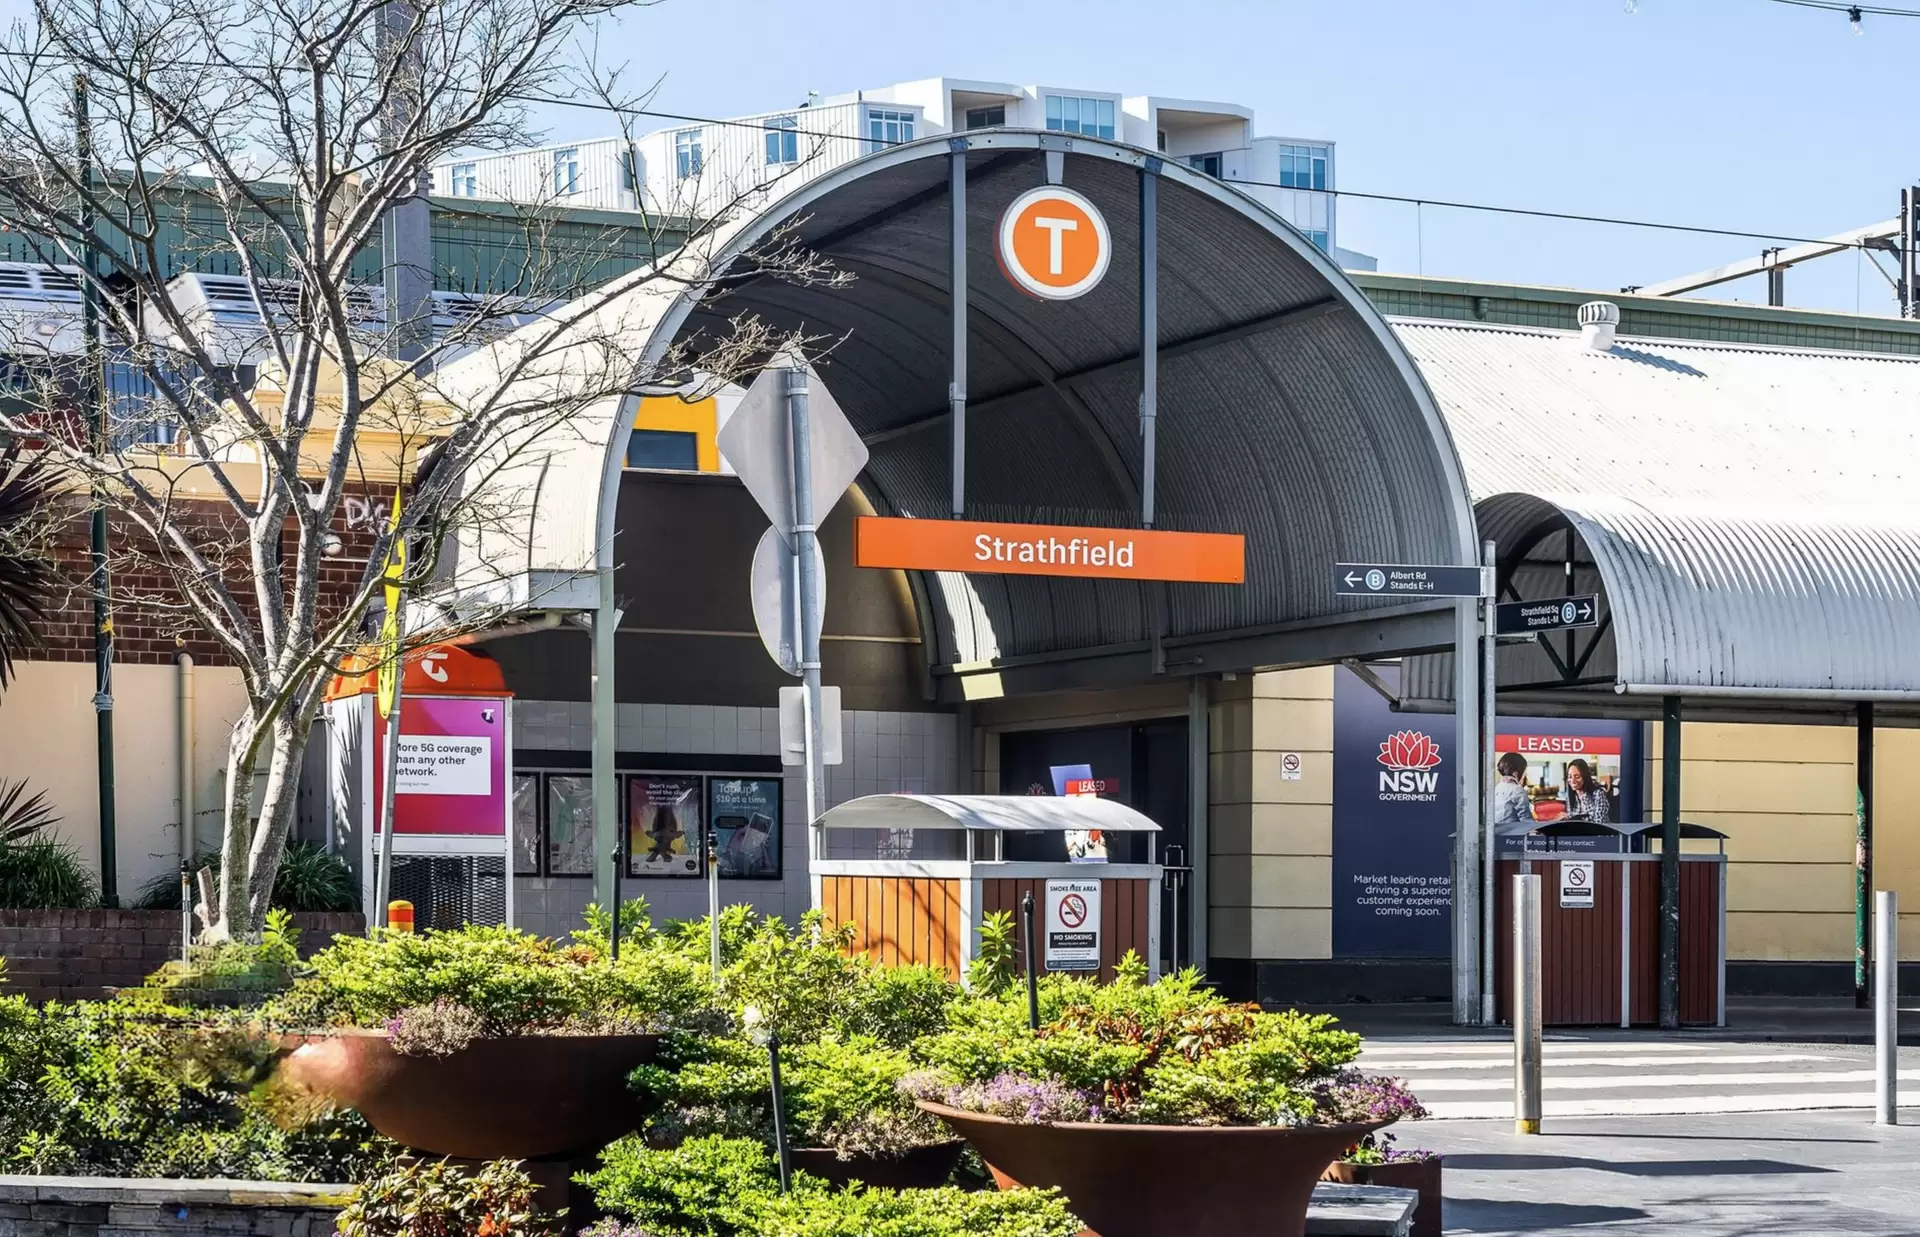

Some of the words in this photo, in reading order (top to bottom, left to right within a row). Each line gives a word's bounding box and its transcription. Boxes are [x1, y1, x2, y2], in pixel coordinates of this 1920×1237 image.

[1035, 216, 1078, 275] T
[974, 534, 1134, 568] Strathfield
[1371, 573, 1380, 586] B
[1390, 571, 1415, 580] Albert
[1416, 572, 1427, 580] Rd
[1390, 581, 1418, 590] Stands
[1419, 582, 1434, 590] E-H
[1521, 605, 1551, 616] Strathfield
[1551, 605, 1559, 614] Sq
[1566, 607, 1573, 619] B
[1527, 616, 1547, 626] Stands
[1547, 615, 1559, 624] L-M
[420, 743, 434, 752] 5G
[437, 745, 482, 756] coverage
[1517, 737, 1585, 752] LEASED
[395, 755, 415, 764] han
[417, 756, 436, 766] any
[438, 755, 466, 765] other
[1079, 780, 1106, 792] LEASED
[1379, 771, 1439, 793] NSW
[716, 794, 730, 804] $10
[731, 795, 740, 803] at
[747, 795, 767, 804] time
[1379, 793, 1437, 802] GOVERNMENT
[1353, 874, 1388, 884] Market
[1390, 875, 1426, 887] leading
[1365, 885, 1400, 896] driving
[1411, 887, 1452, 896] superior
[1356, 896, 1404, 905] customer
[1406, 897, 1452, 906] experienc
[1375, 906, 1412, 917] coming
[1415, 907, 1441, 916] soon.
